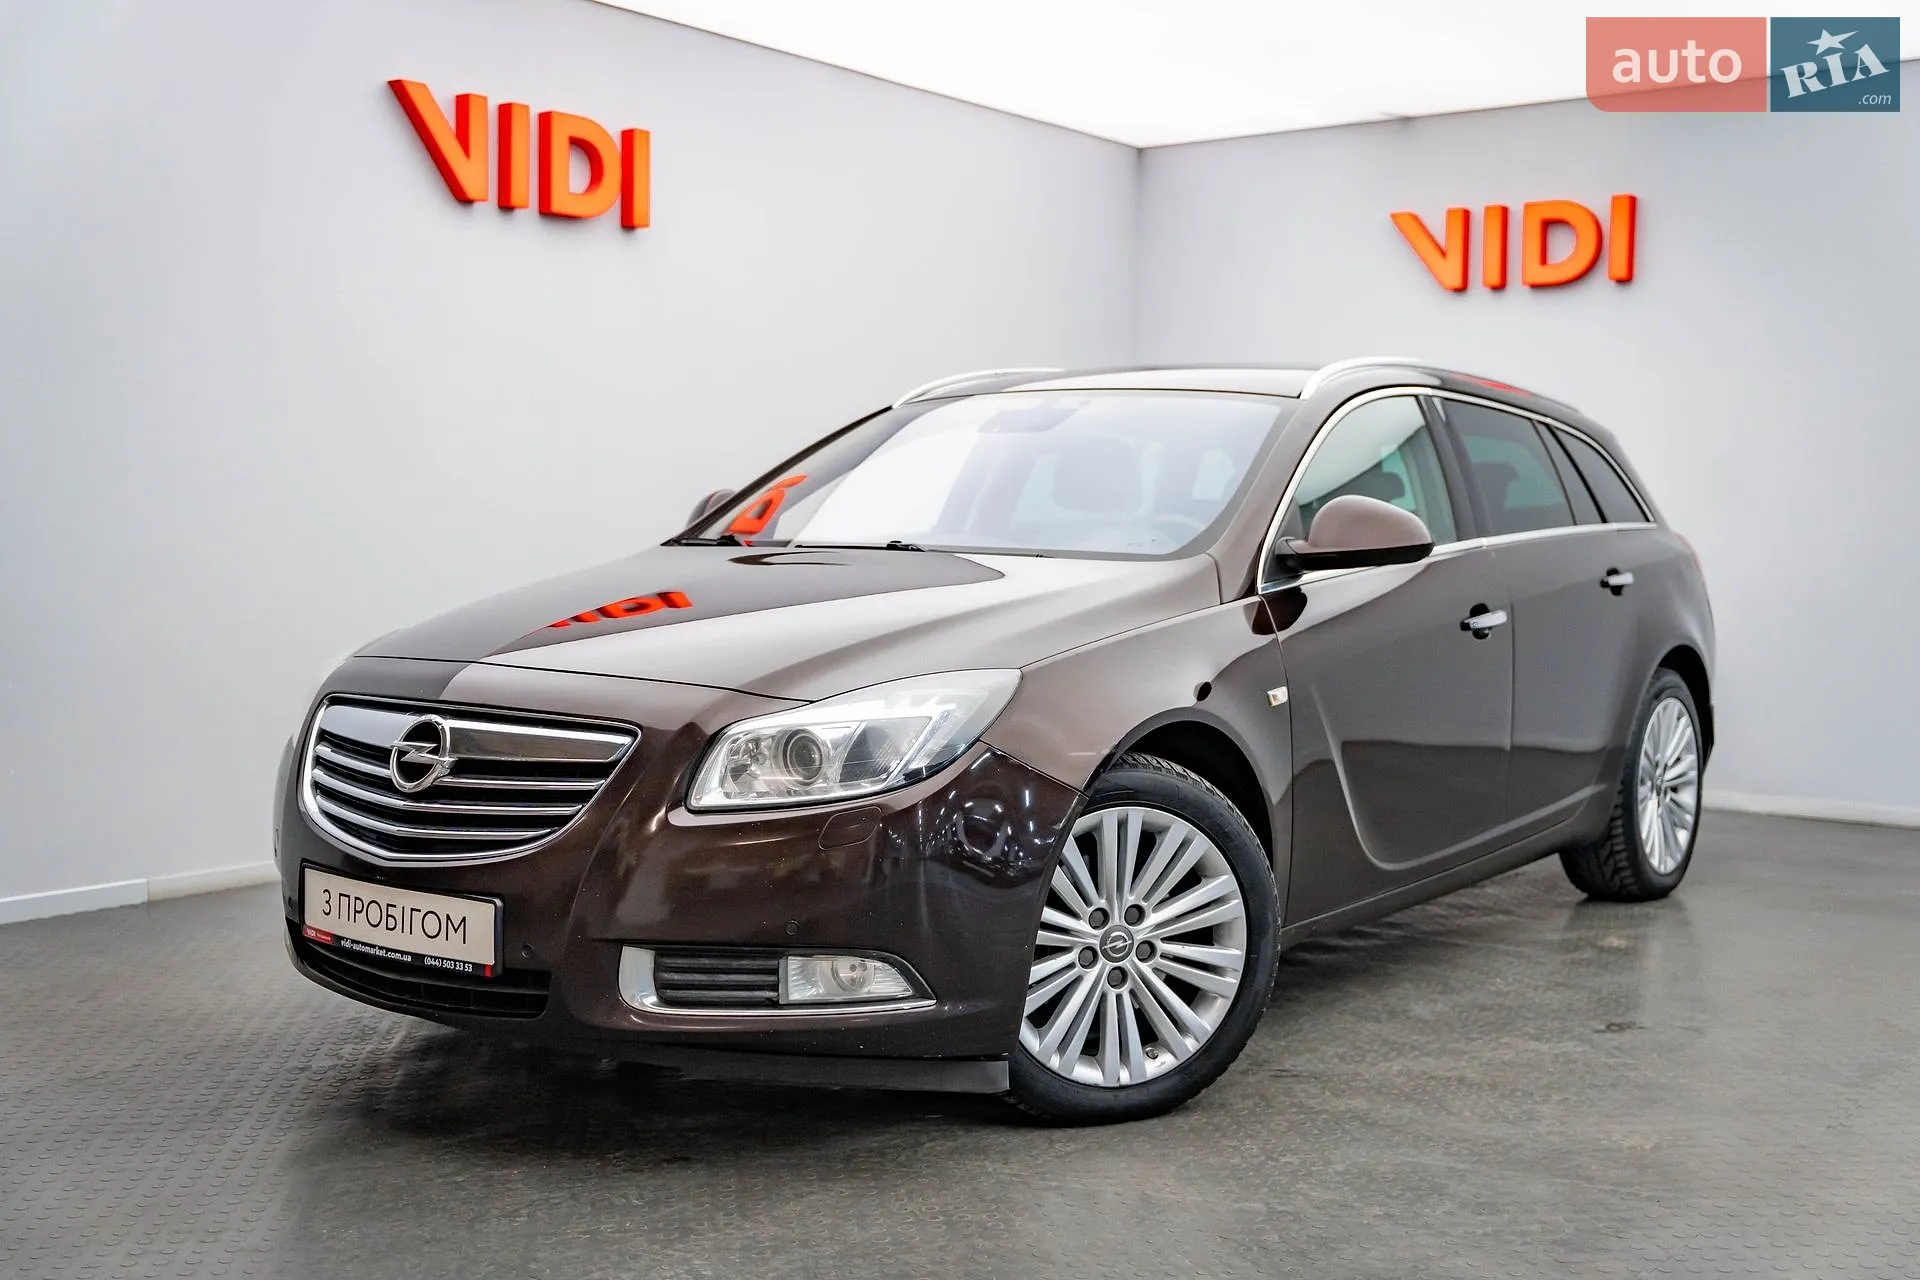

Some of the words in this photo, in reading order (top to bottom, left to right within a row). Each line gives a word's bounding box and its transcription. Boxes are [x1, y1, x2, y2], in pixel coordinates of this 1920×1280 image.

[387, 78, 650, 230] VIDI
[1389, 193, 1638, 291] VIDI
[338, 892, 467, 945] ПРОБІГОМ
[340, 938, 412, 962] vidi-automarket.com.ua
[424, 955, 442, 968] (044)
[442, 960, 455, 969] 503
[455, 962, 464, 971] 33
[464, 963, 473, 972] 53
